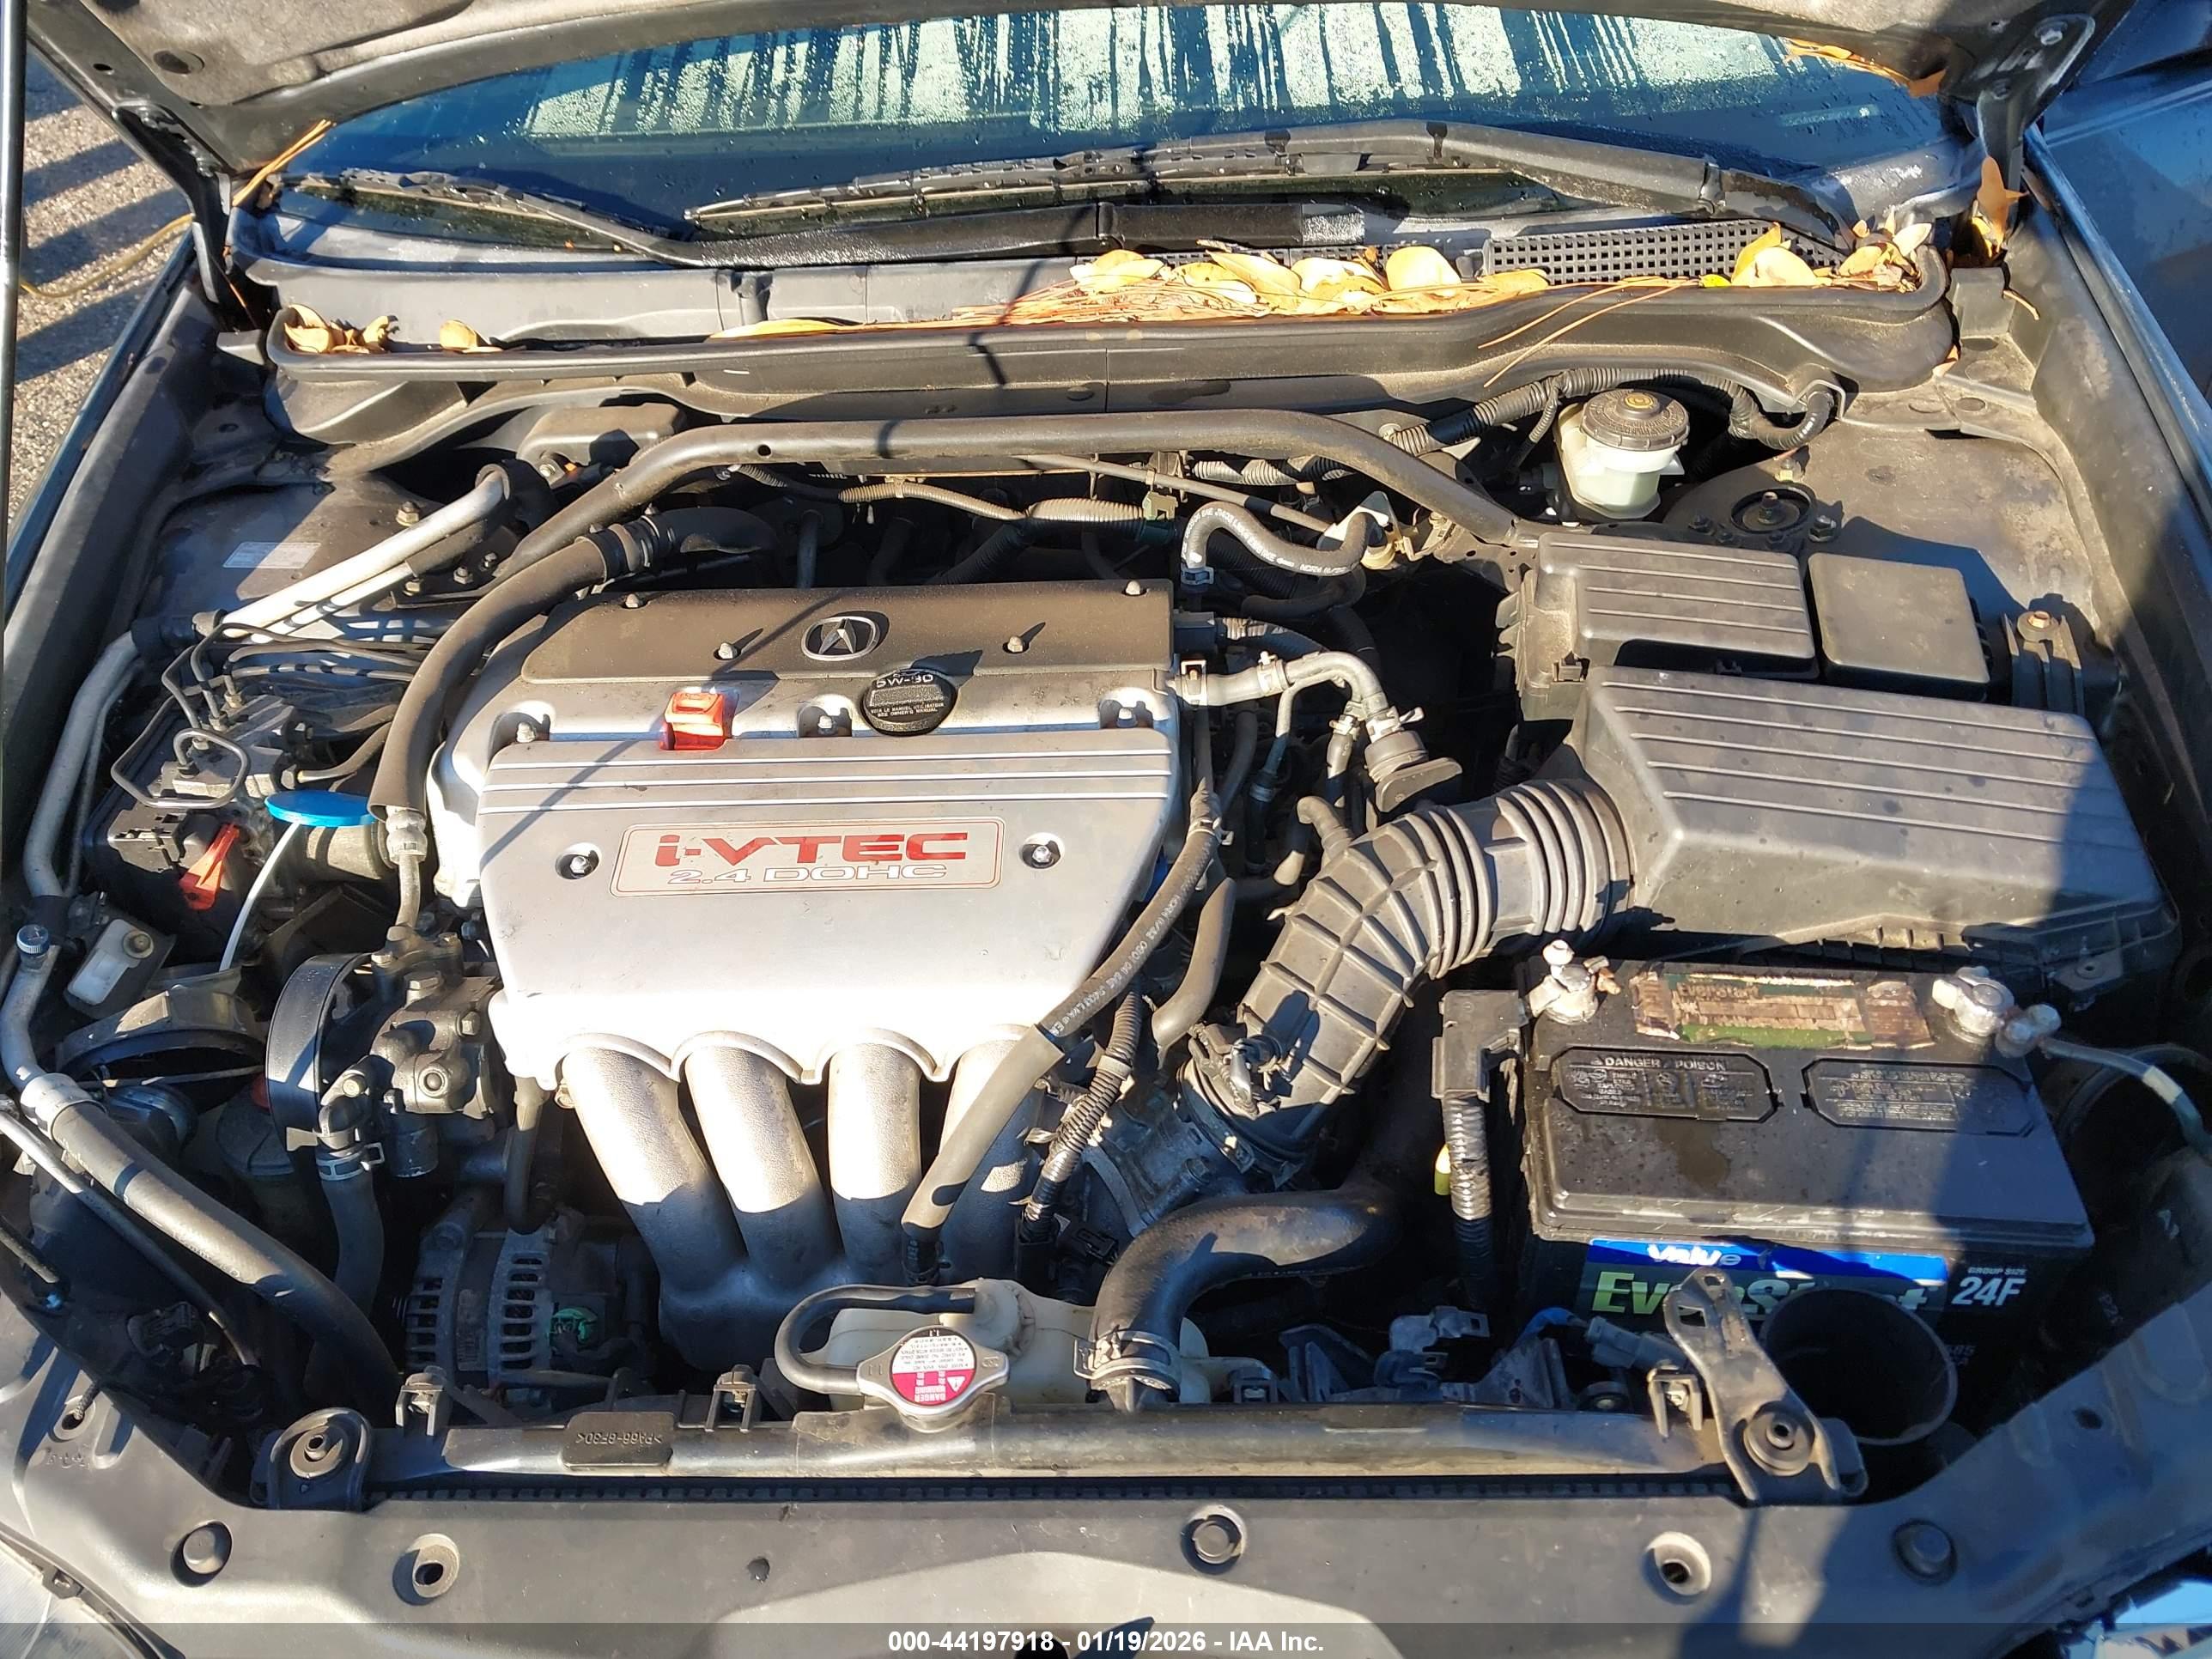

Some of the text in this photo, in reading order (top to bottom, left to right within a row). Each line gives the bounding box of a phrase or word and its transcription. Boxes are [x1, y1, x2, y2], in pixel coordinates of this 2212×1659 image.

[876, 673, 934, 689] 5W-30
[654, 832, 969, 867] i-VTEC
[666, 864, 948, 884] 2.4 DOHC
[1605, 1056, 1662, 1068] DANGER
[1675, 1060, 1727, 1072] POISON
[1646, 1243, 1742, 1267] Value
[1951, 1276, 2027, 1306] 24F
[914, 1393, 947, 1403] DANGER
